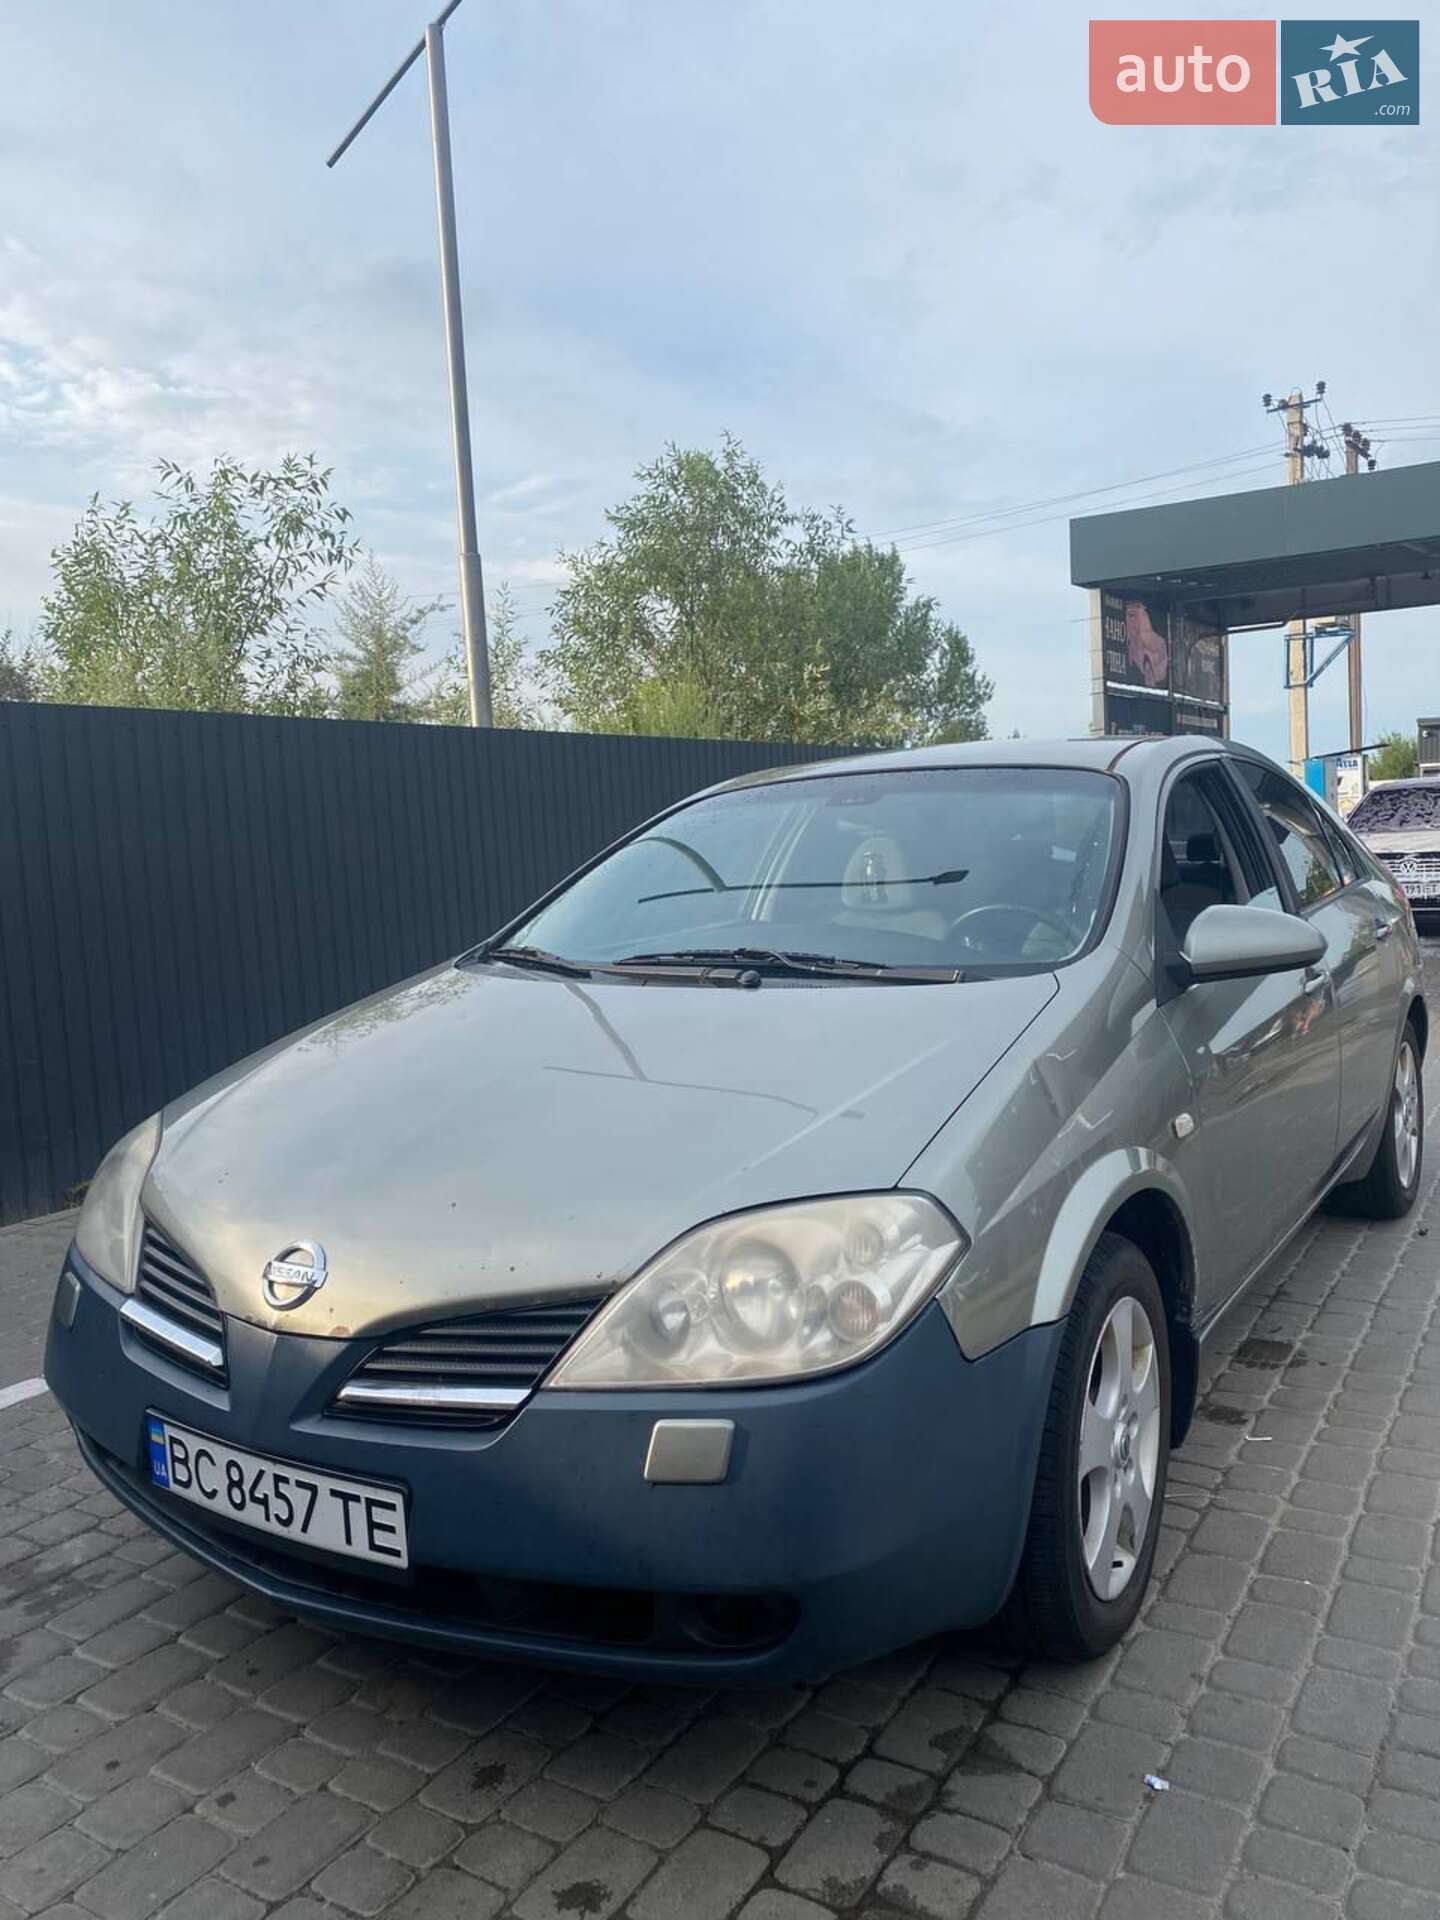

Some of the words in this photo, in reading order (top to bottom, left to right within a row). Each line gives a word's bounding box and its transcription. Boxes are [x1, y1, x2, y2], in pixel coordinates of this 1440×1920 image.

[153, 1462, 168, 1478] UA
[225, 1459, 319, 1534] 8457
[329, 1487, 402, 1559] TE
